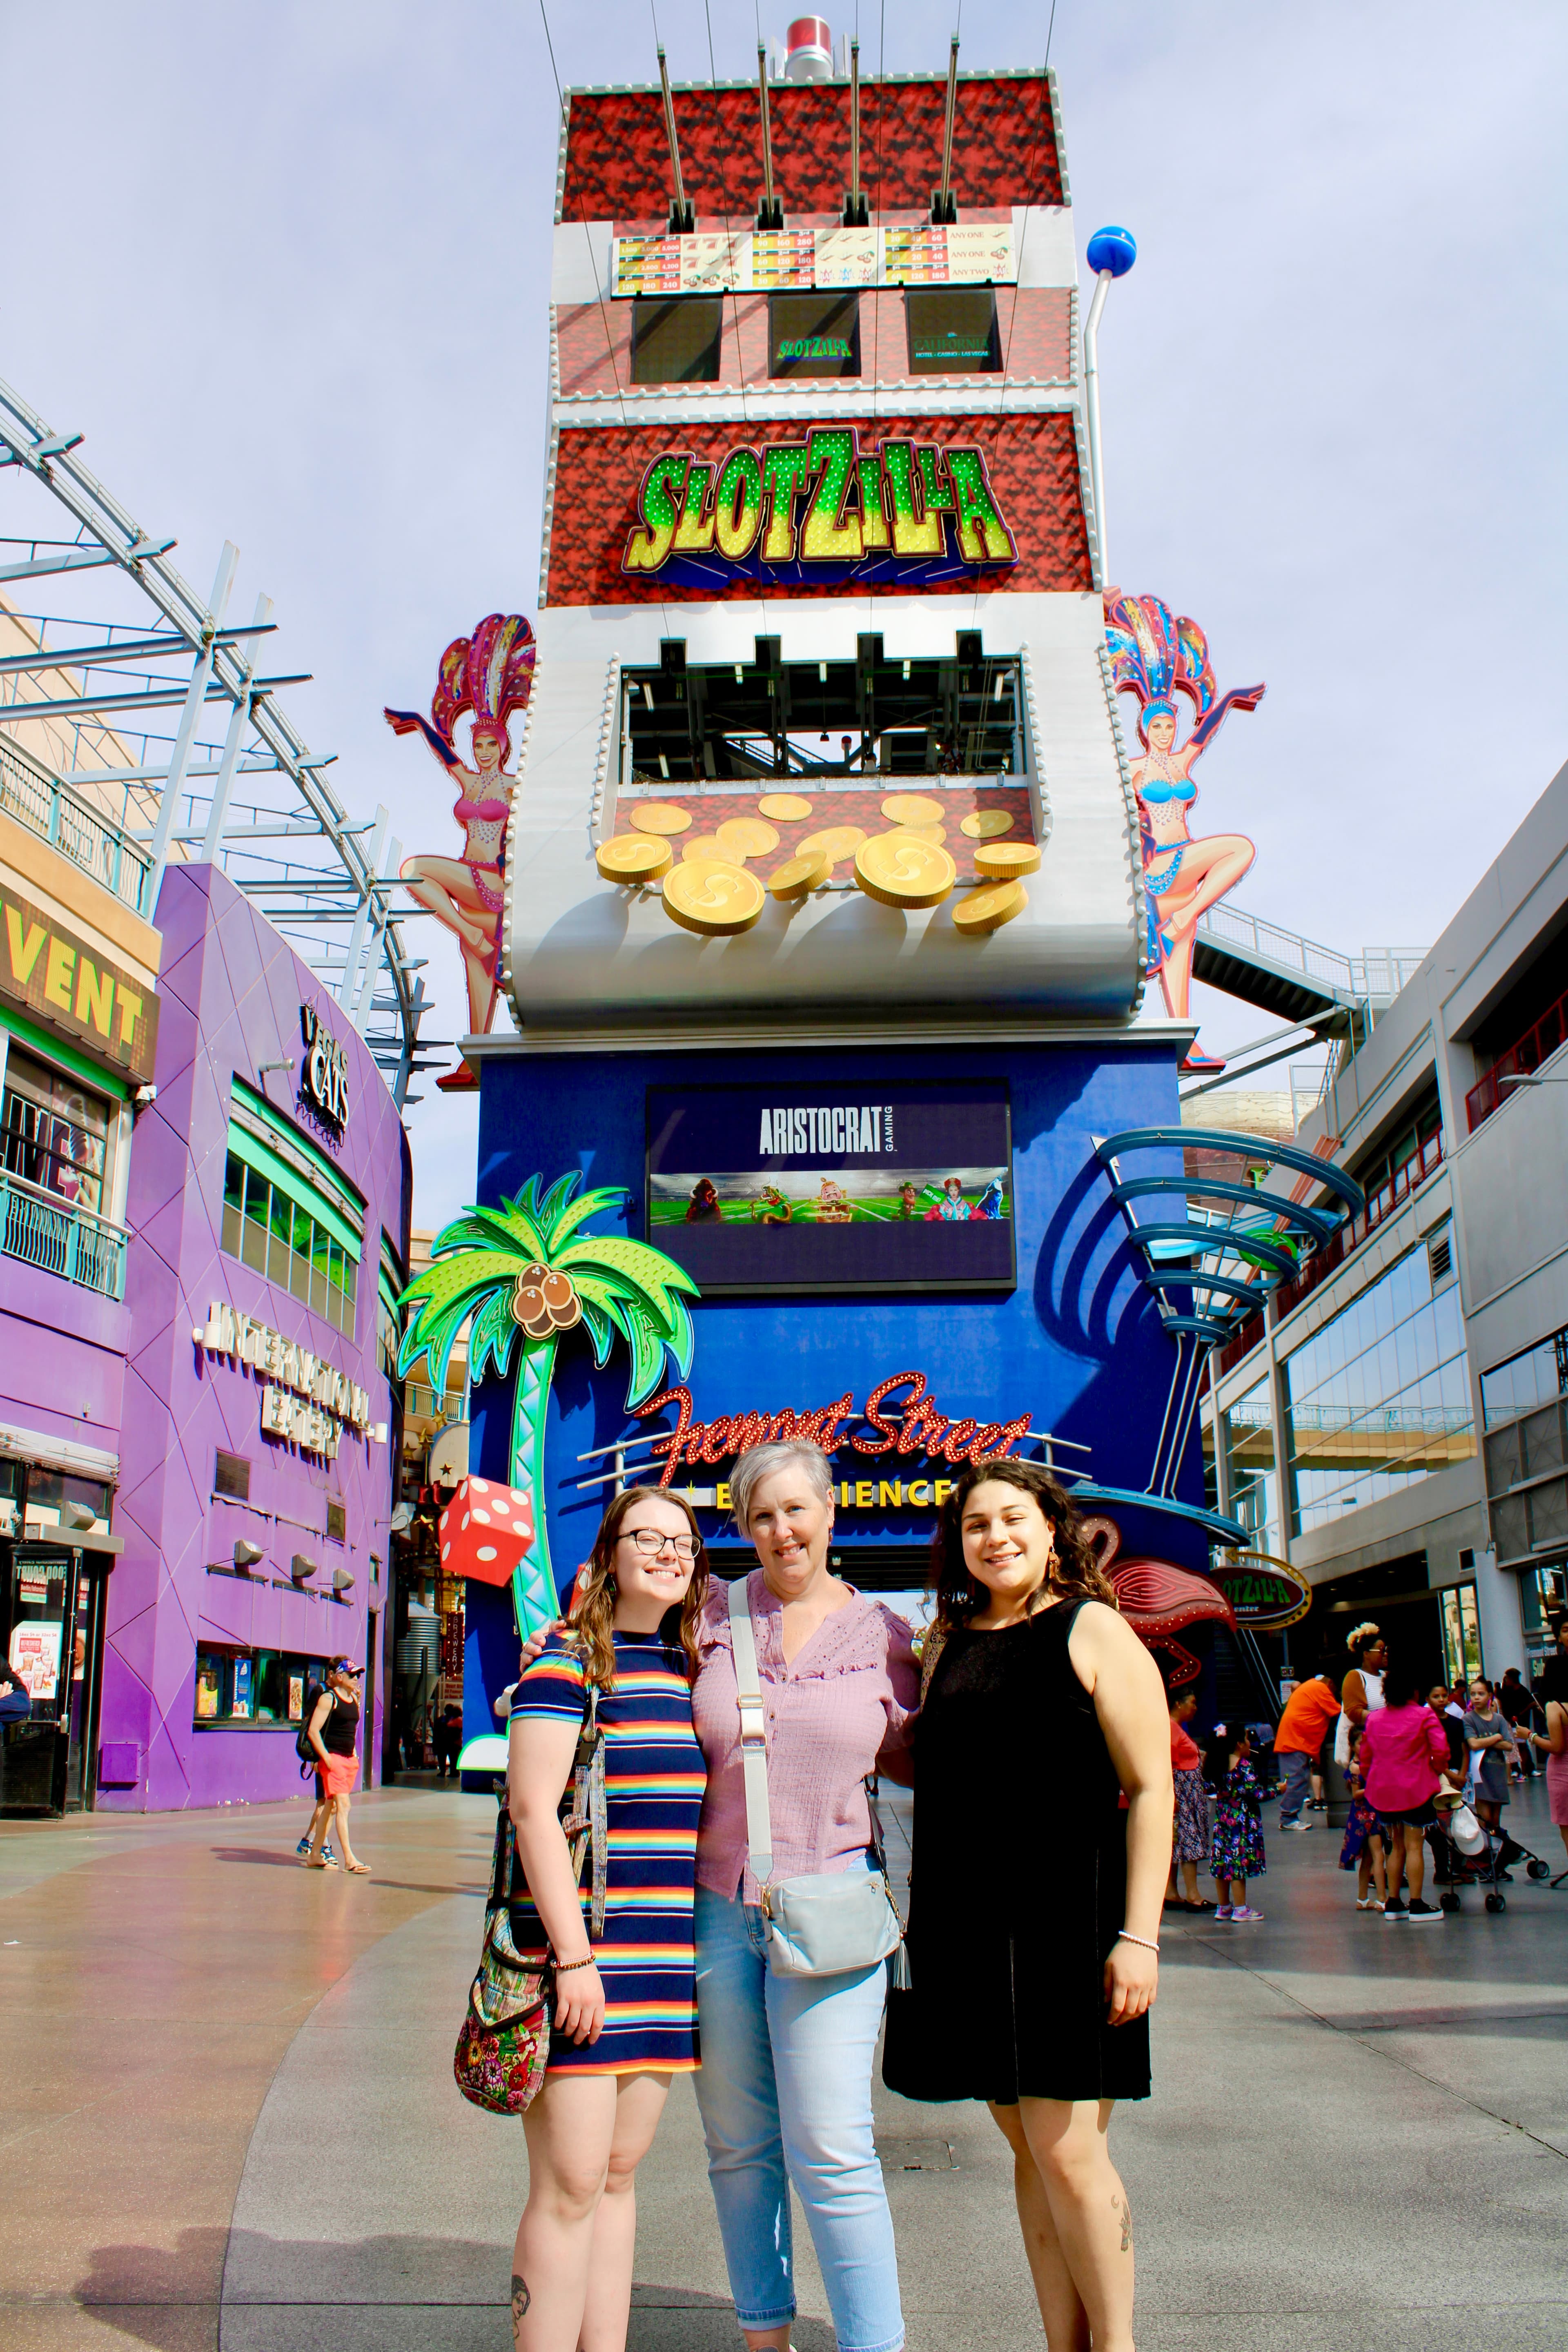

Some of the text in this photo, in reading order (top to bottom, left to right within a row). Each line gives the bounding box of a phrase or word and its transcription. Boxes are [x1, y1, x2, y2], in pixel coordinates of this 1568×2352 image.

[914, 339, 989, 350] CALIFORNIA
[0, 900, 143, 1046] VENT
[305, 1004, 348, 1079] VEGAS
[310, 1045, 350, 1126] CATS
[760, 1107, 882, 1154] ARISTOCRAT
[884, 1106, 893, 1152] GAMING
[261, 1385, 343, 1459] EATERY
[634, 1371, 1033, 1488] Fremont Street
[717, 1480, 951, 1509] EIENCE
[1223, 1575, 1291, 1603] OTZILLA
